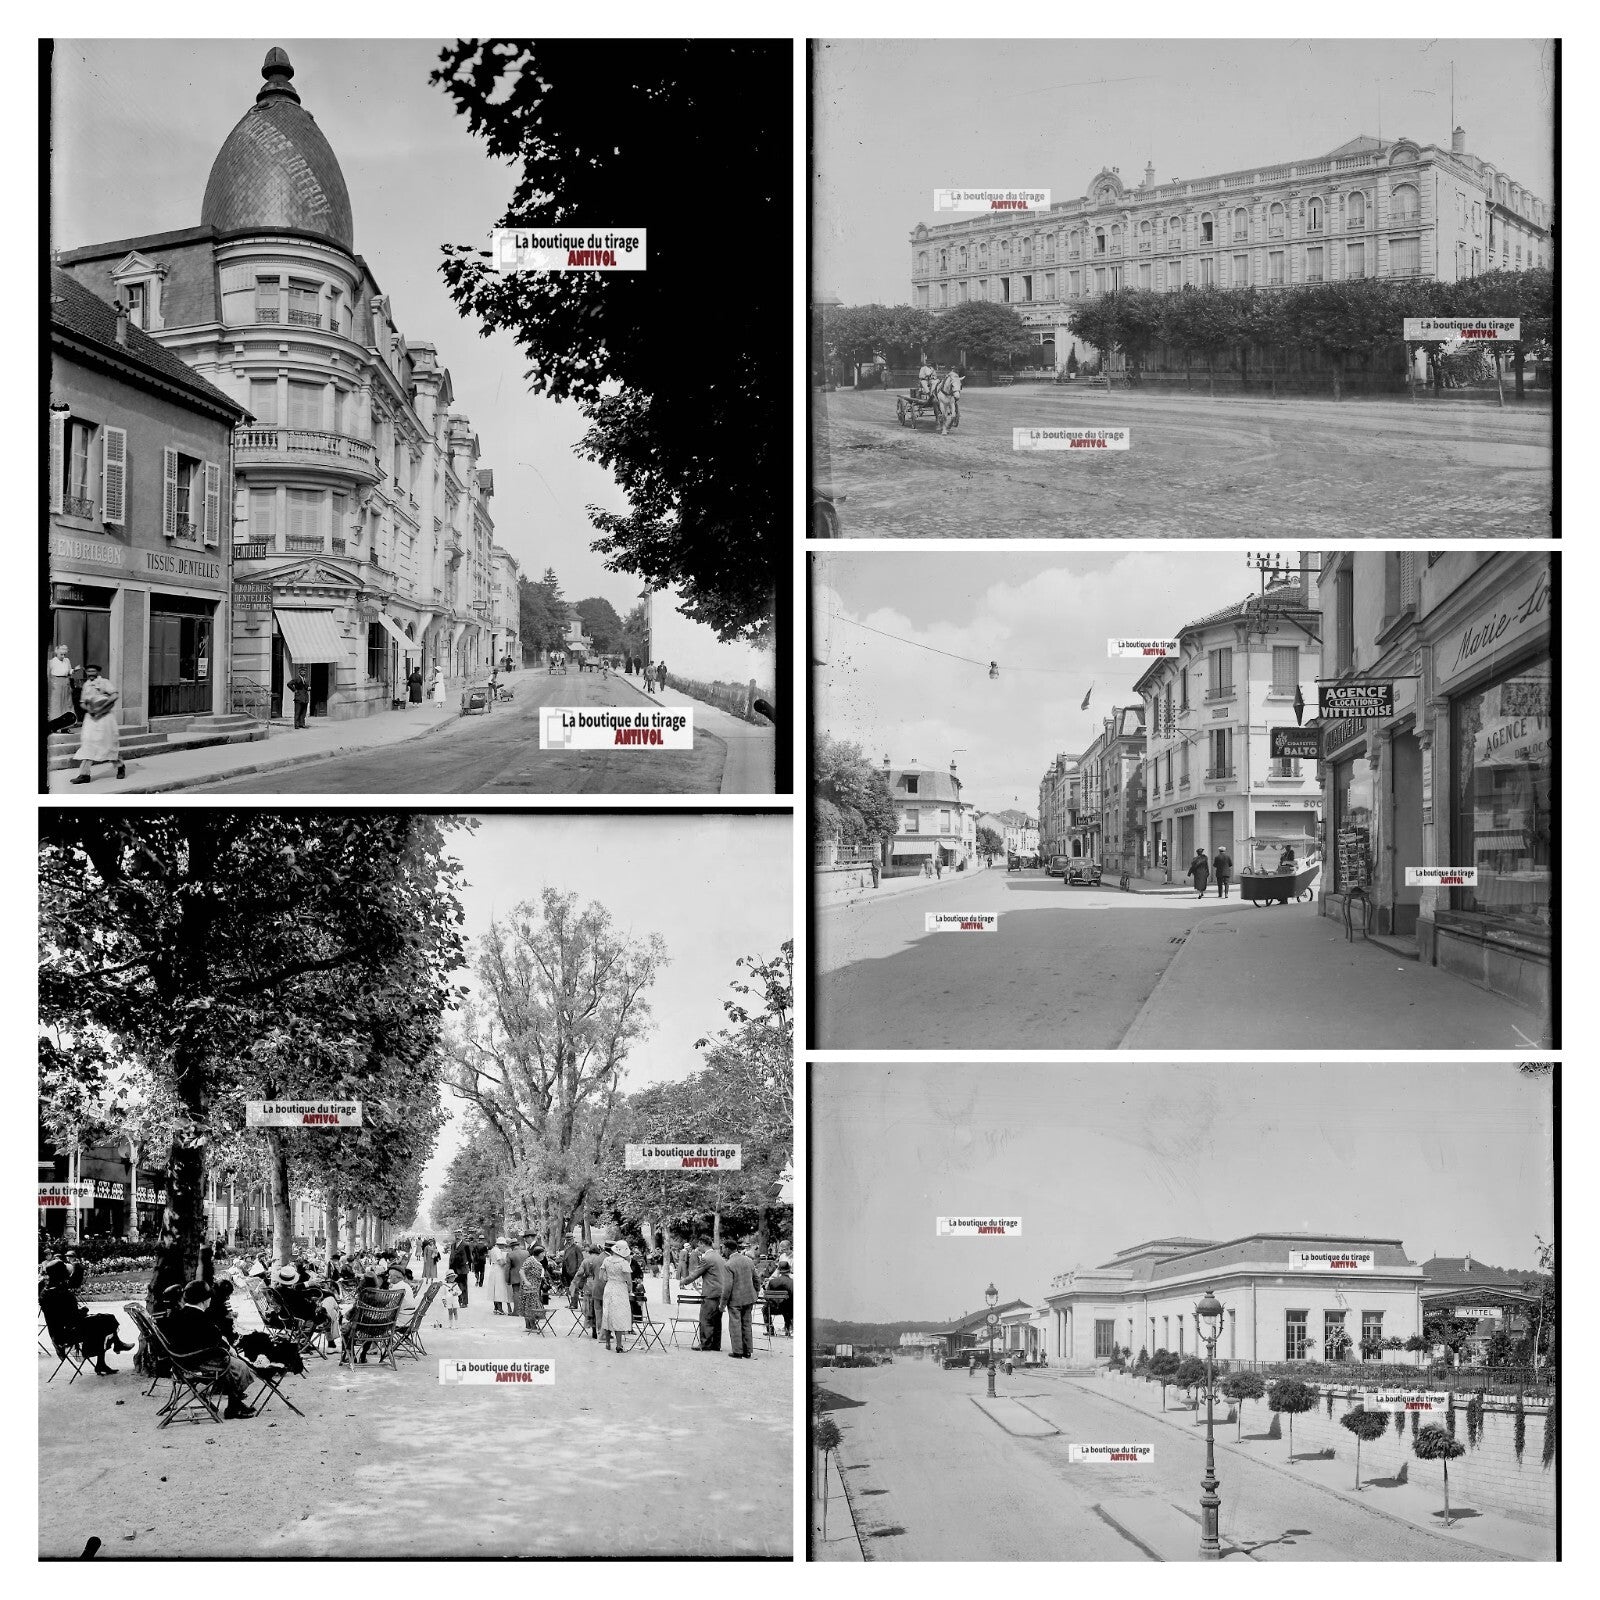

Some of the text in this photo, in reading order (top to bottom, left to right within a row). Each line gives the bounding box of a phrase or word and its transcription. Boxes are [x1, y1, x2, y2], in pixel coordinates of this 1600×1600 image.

[234, 594, 272, 603] DENTELLES
[1326, 686, 1388, 700] AGENCE
[1334, 699, 1379, 707] LOCATIONS
[1321, 704, 1392, 718] VITTELLOISE
[1486, 717, 1528, 754] AGENCE
[1284, 747, 1318, 756] BALTO
